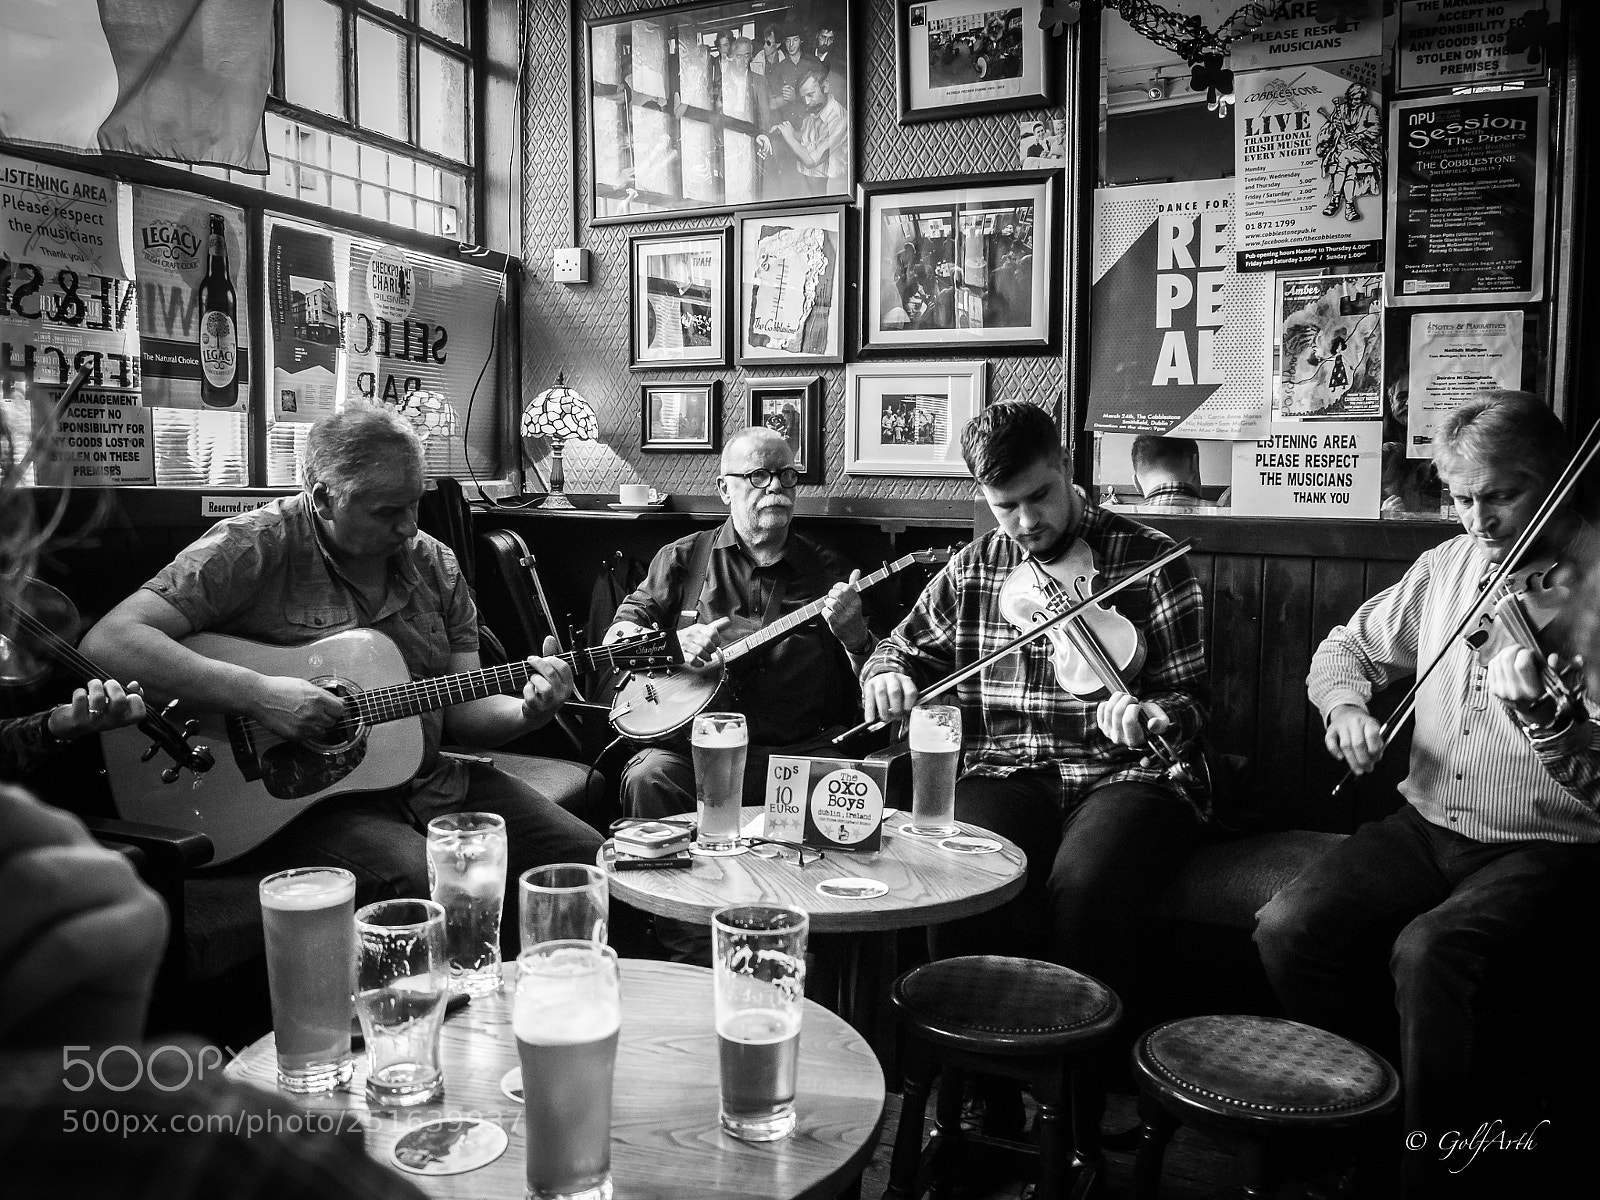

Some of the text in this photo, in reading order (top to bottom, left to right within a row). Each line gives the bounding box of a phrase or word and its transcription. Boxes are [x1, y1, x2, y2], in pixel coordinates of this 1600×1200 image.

[1273, 0, 1318, 21] ARE
[1416, 2, 1439, 12] THE
[1438, 6, 1504, 22] ACCEPT NO
[1252, 22, 1360, 43] PLEASE RESPCT
[1409, 17, 1524, 39] RESPONSIBILITY FO
[1269, 38, 1342, 54] MUSICIANS
[1409, 41, 1433, 53] ANY
[1437, 35, 1477, 49] GOODS
[1416, 50, 1461, 64] STOLEN
[1465, 48, 1482, 59] ON
[1349, 64, 1377, 79] COVER
[1364, 62, 1377, 71] NO
[1440, 61, 1499, 75] PREMISES
[1340, 68, 1377, 87] CHARGE
[1244, 110, 1311, 137] LIVE
[1244, 131, 1311, 145] TRADITIONAL
[1408, 114, 1527, 149] Session
[1244, 139, 1311, 154] IRISH MUSIC
[1444, 133, 1527, 146] The Pipers
[1244, 148, 1312, 162] EVERY NIGHT
[1416, 155, 1516, 171] THE COBBLESTONE
[1269, 172, 1300, 180] Wednesday
[0, 167, 107, 202] ISTENING AREA
[3, 193, 104, 226] Please respect
[1158, 200, 1229, 213] DANCE FOR
[8, 218, 103, 246] the musicians
[1245, 219, 1295, 231] 01 872 1799
[142, 226, 202, 257] LEGACY
[40, 245, 85, 263] Thank you
[1256, 251, 1279, 259] opening
[1296, 247, 1318, 255] Monday
[1245, 260, 1263, 268] Friday
[374, 293, 410, 306] PILSNER
[143, 352, 199, 365] The Natural Choice
[203, 349, 235, 367] LEGACY
[67, 407, 121, 419] ACCEPT NO
[126, 423, 145, 434] FOR
[68, 436, 102, 447] GOODS
[105, 438, 130, 447] LOST
[131, 438, 145, 448] OR
[1256, 434, 1357, 449] LISTENING AREA
[93, 451, 107, 462] ON
[109, 451, 140, 462] THESE
[1255, 453, 1360, 469] PLEASE RESPECT
[73, 464, 121, 477] PREMISES
[1259, 472, 1353, 487] THE MUSICIANS
[1294, 491, 1350, 504] THANK YOU
[208, 501, 241, 512] Reserved
[635, 641, 667, 655] Stanford
[840, 772, 858, 781] The
[775, 785, 793, 806] 10
[828, 780, 868, 797] OXO
[769, 803, 800, 814] EURO
